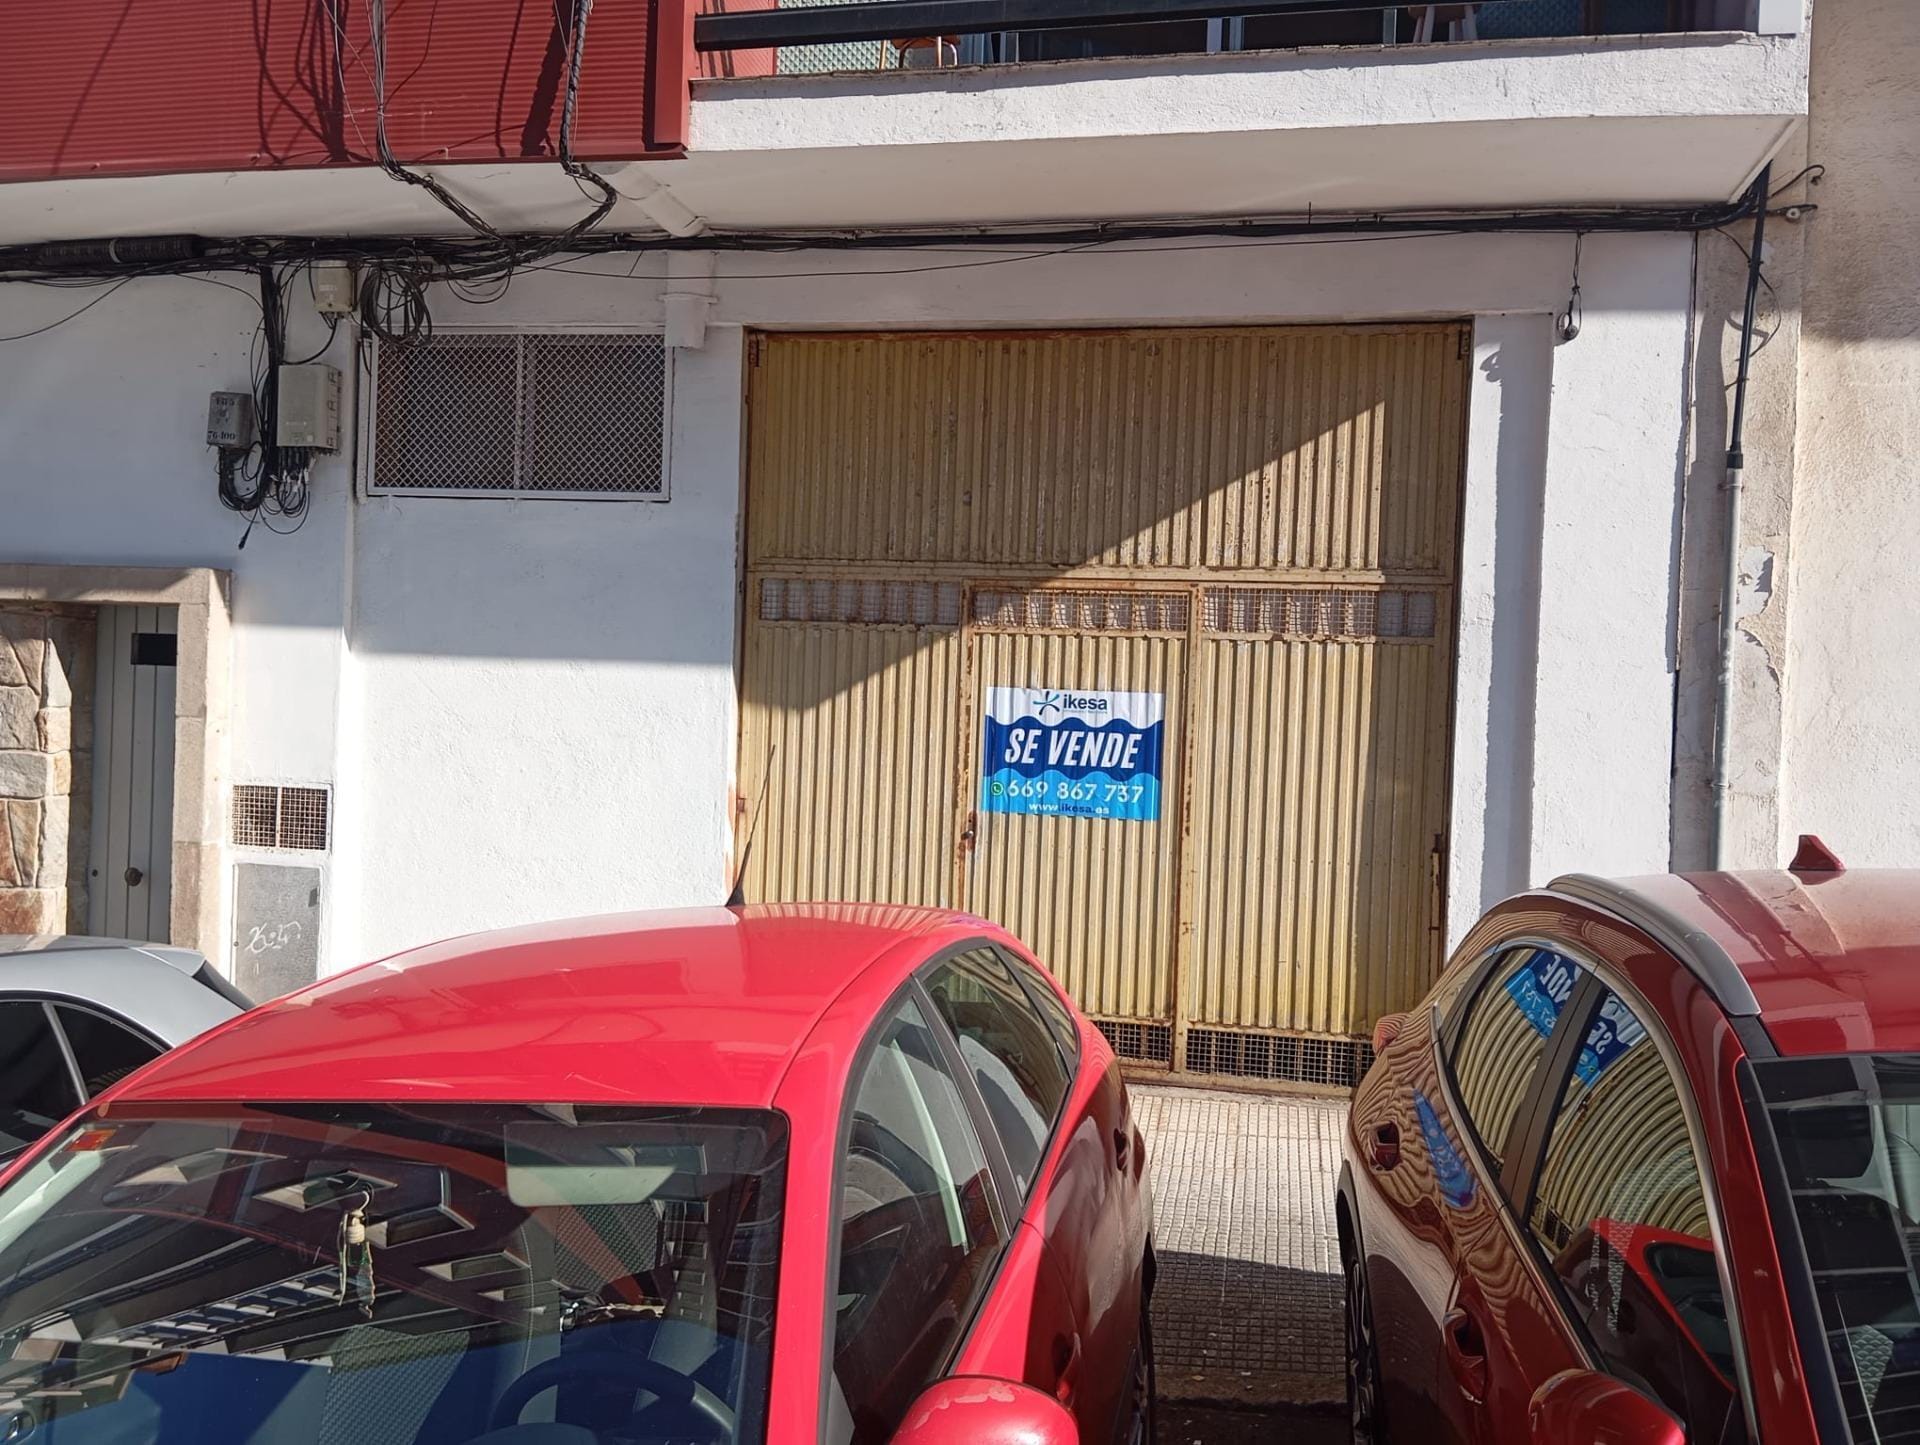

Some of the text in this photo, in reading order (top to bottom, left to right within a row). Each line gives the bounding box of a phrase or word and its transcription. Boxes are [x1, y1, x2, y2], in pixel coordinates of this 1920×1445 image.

[1063, 694, 1108, 710] ikesa
[1004, 728, 1142, 769] SE VENDE
[1007, 780, 1144, 804] 669 867 737
[1028, 802, 1110, 815] www.ikesa.es
